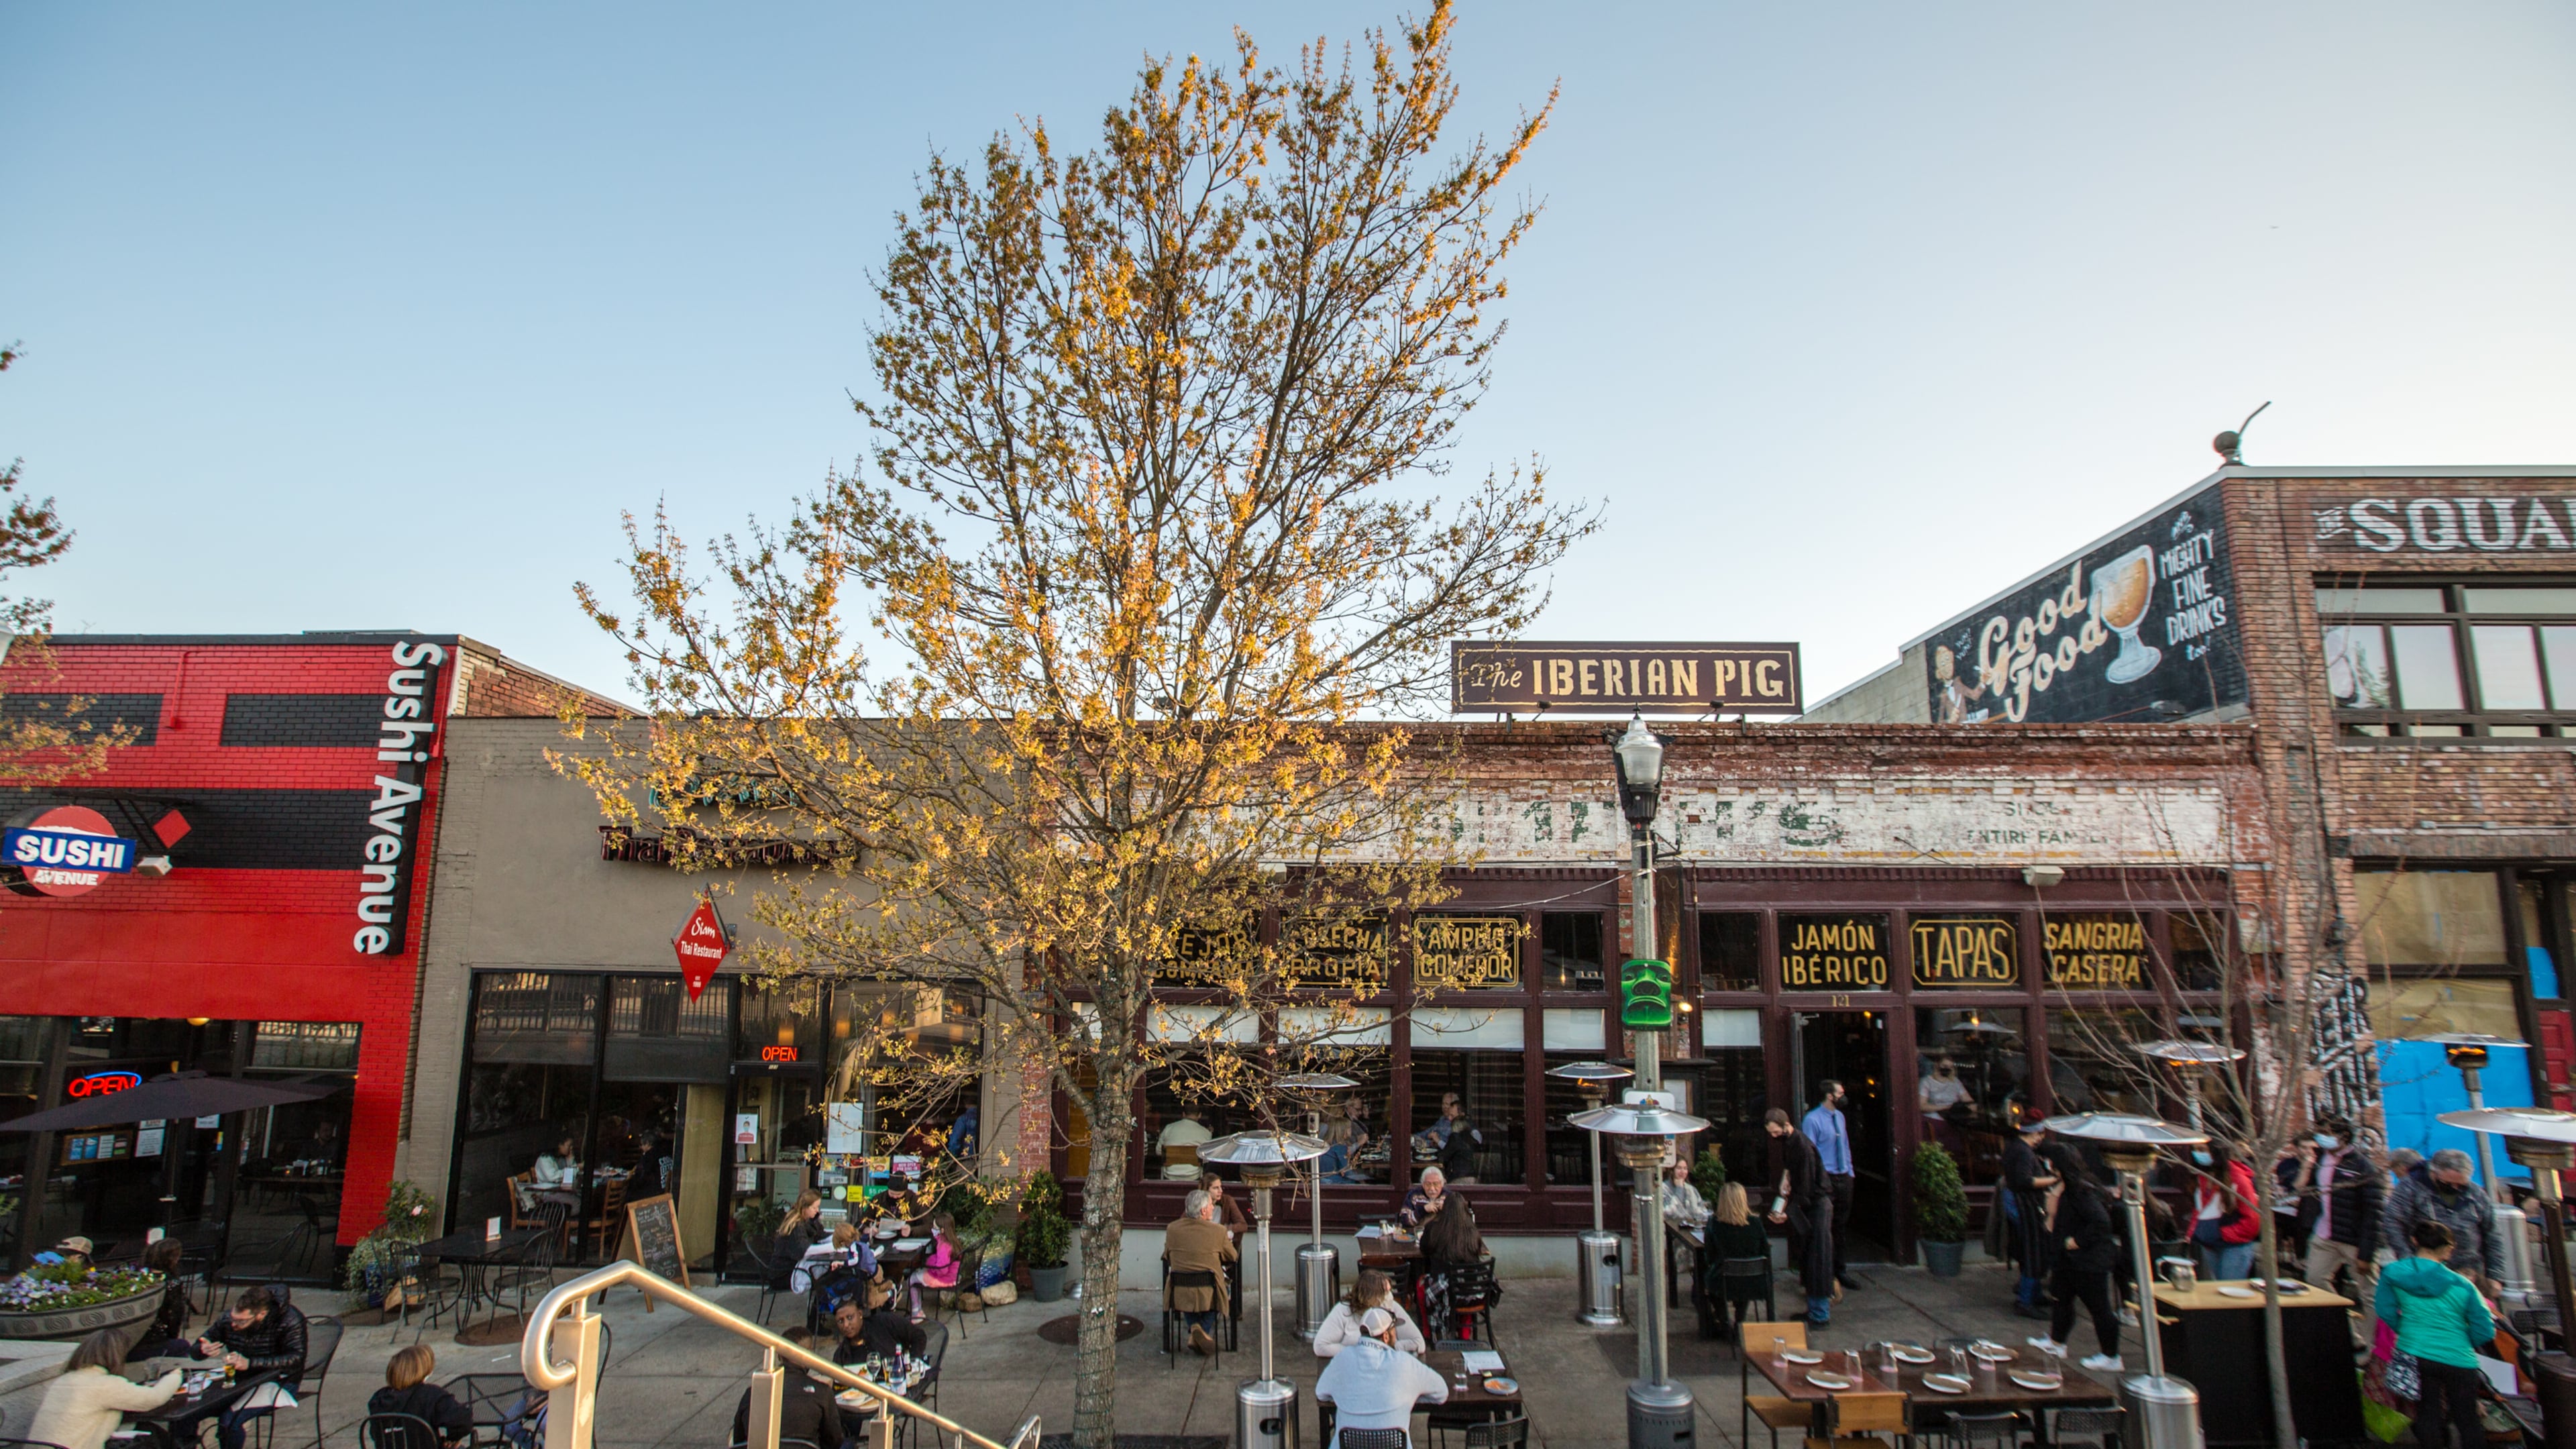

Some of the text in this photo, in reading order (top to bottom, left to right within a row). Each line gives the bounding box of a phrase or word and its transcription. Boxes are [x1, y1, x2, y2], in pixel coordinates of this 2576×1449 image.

[2159, 529, 2214, 579] MIGHTY
[2171, 566, 2213, 609] FINE
[1980, 559, 2088, 696] Good
[2166, 596, 2226, 646] DRINKS
[2004, 590, 2108, 722] Food
[1470, 659, 1784, 697] The IBERIAN PIG
[353, 641, 444, 955] Sushi Avenue
[13, 835, 126, 869] SUSHI
[34, 869, 99, 886] AVENUE
[691, 916, 716, 938] Siam
[1792, 920, 1876, 951] JAMÓN
[2044, 922, 2145, 951] SANGRIA
[681, 941, 722, 959] Thai Restaurant
[1916, 926, 2010, 979] TAPAS
[1420, 953, 1513, 979] COMEDOR
[1782, 953, 1888, 985] IBÉRICO
[2053, 954, 2142, 983] CASERA
[1831, 995, 1850, 1007] 121
[761, 1046, 798, 1061] OPEN
[68, 1075, 137, 1097] OPEN
